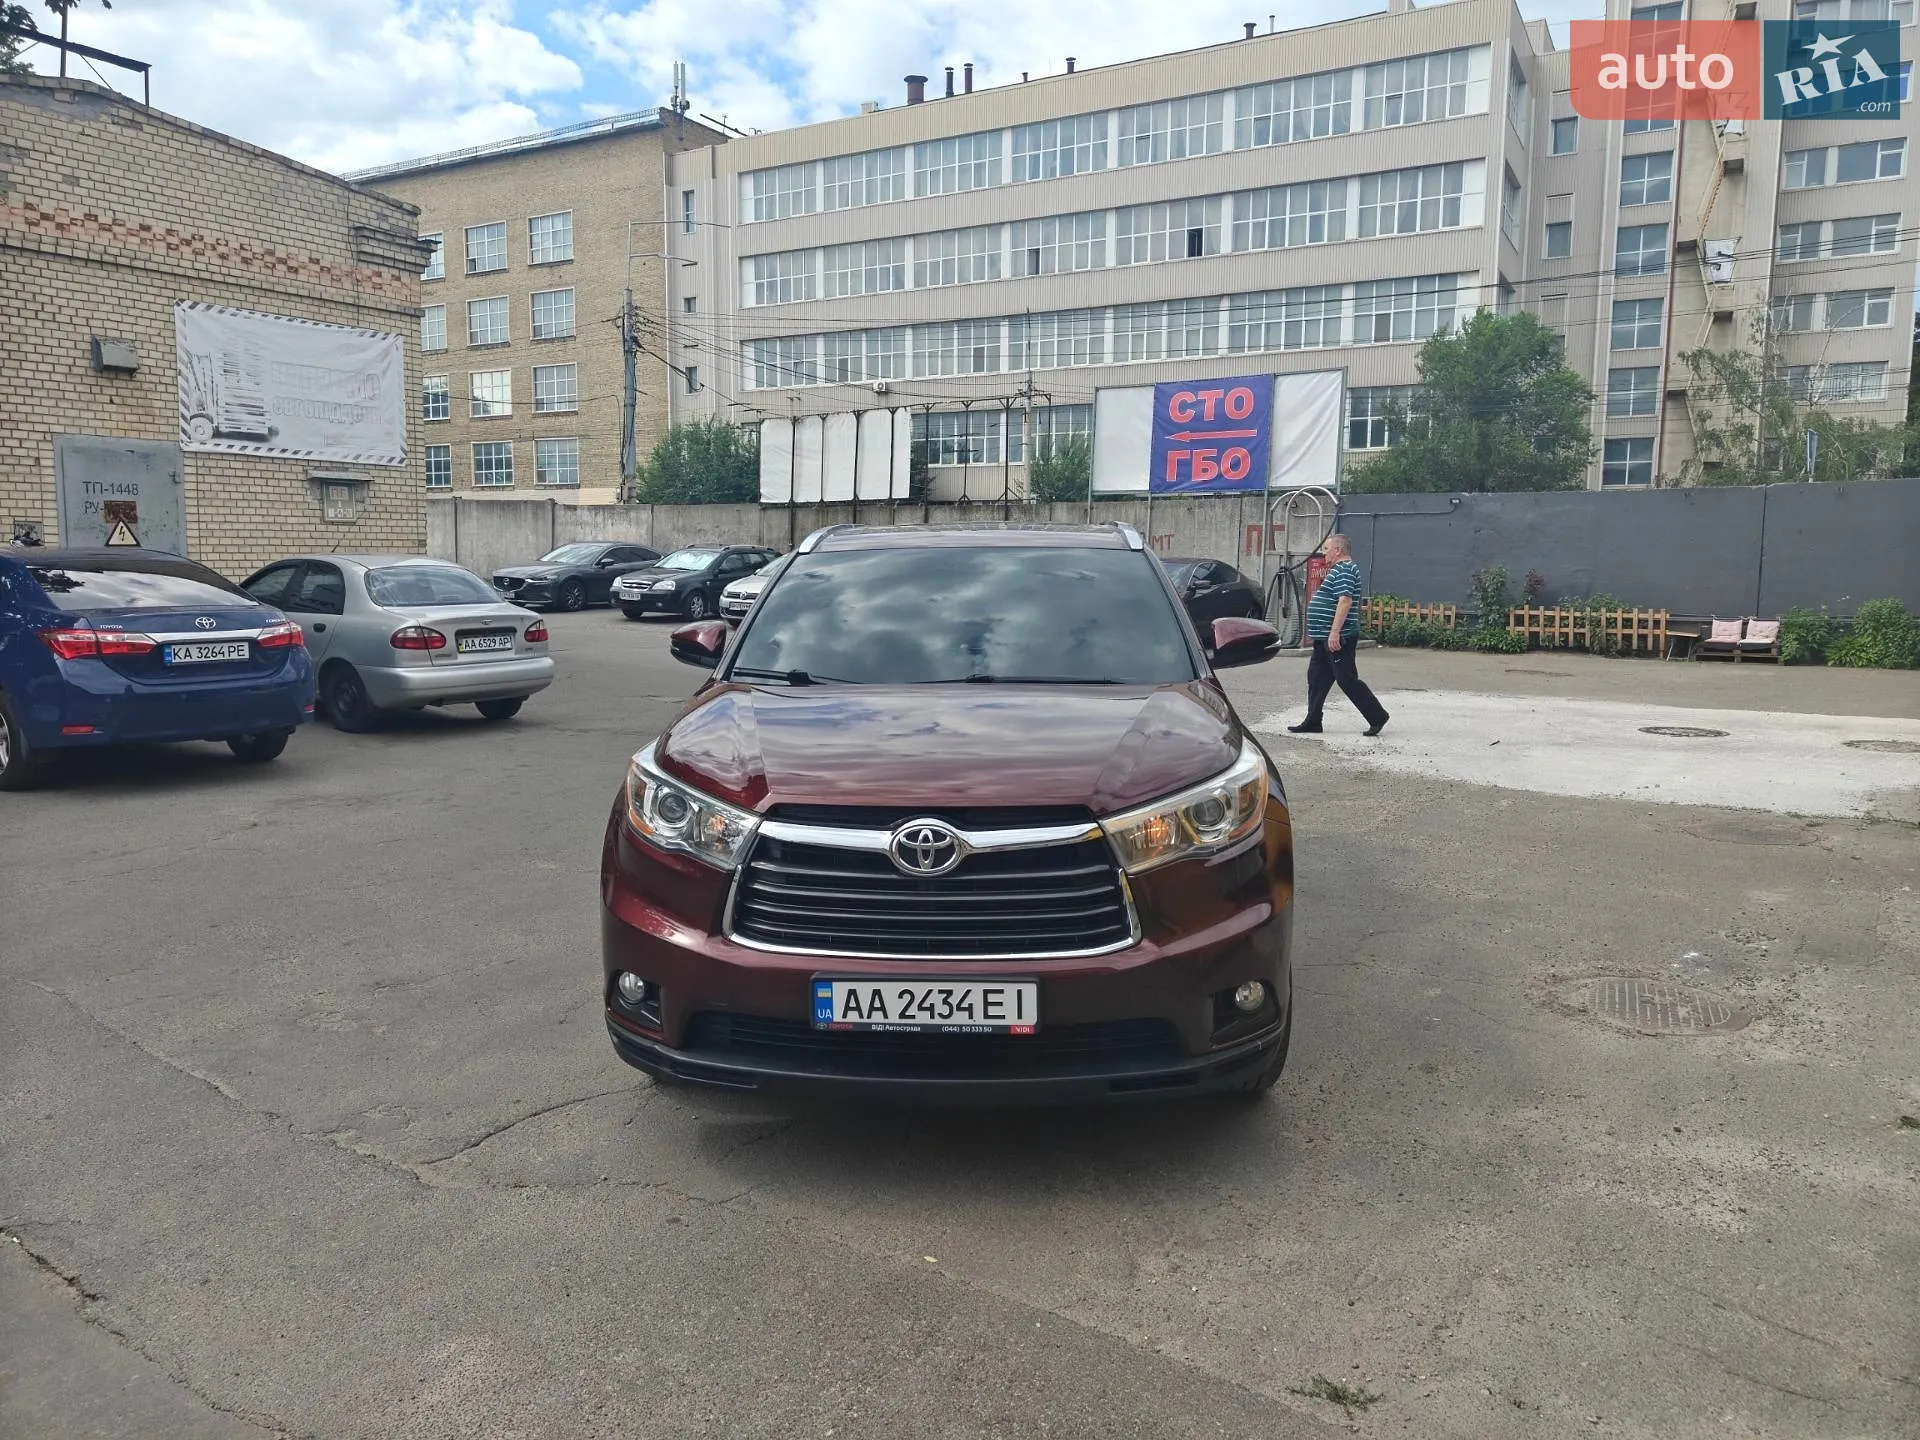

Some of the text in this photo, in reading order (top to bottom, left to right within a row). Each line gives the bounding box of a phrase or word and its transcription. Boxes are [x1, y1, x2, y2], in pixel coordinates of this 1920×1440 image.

[1168, 386, 1254, 423] СТО
[1166, 447, 1251, 482] ГБО
[82, 481, 139, 496] ТП-1448
[172, 647, 193, 660] KA
[196, 646, 225, 659] 3264
[227, 644, 246, 657] PE
[818, 1008, 833, 1019] UA
[841, 988, 1023, 1020] AA 2434 EI
